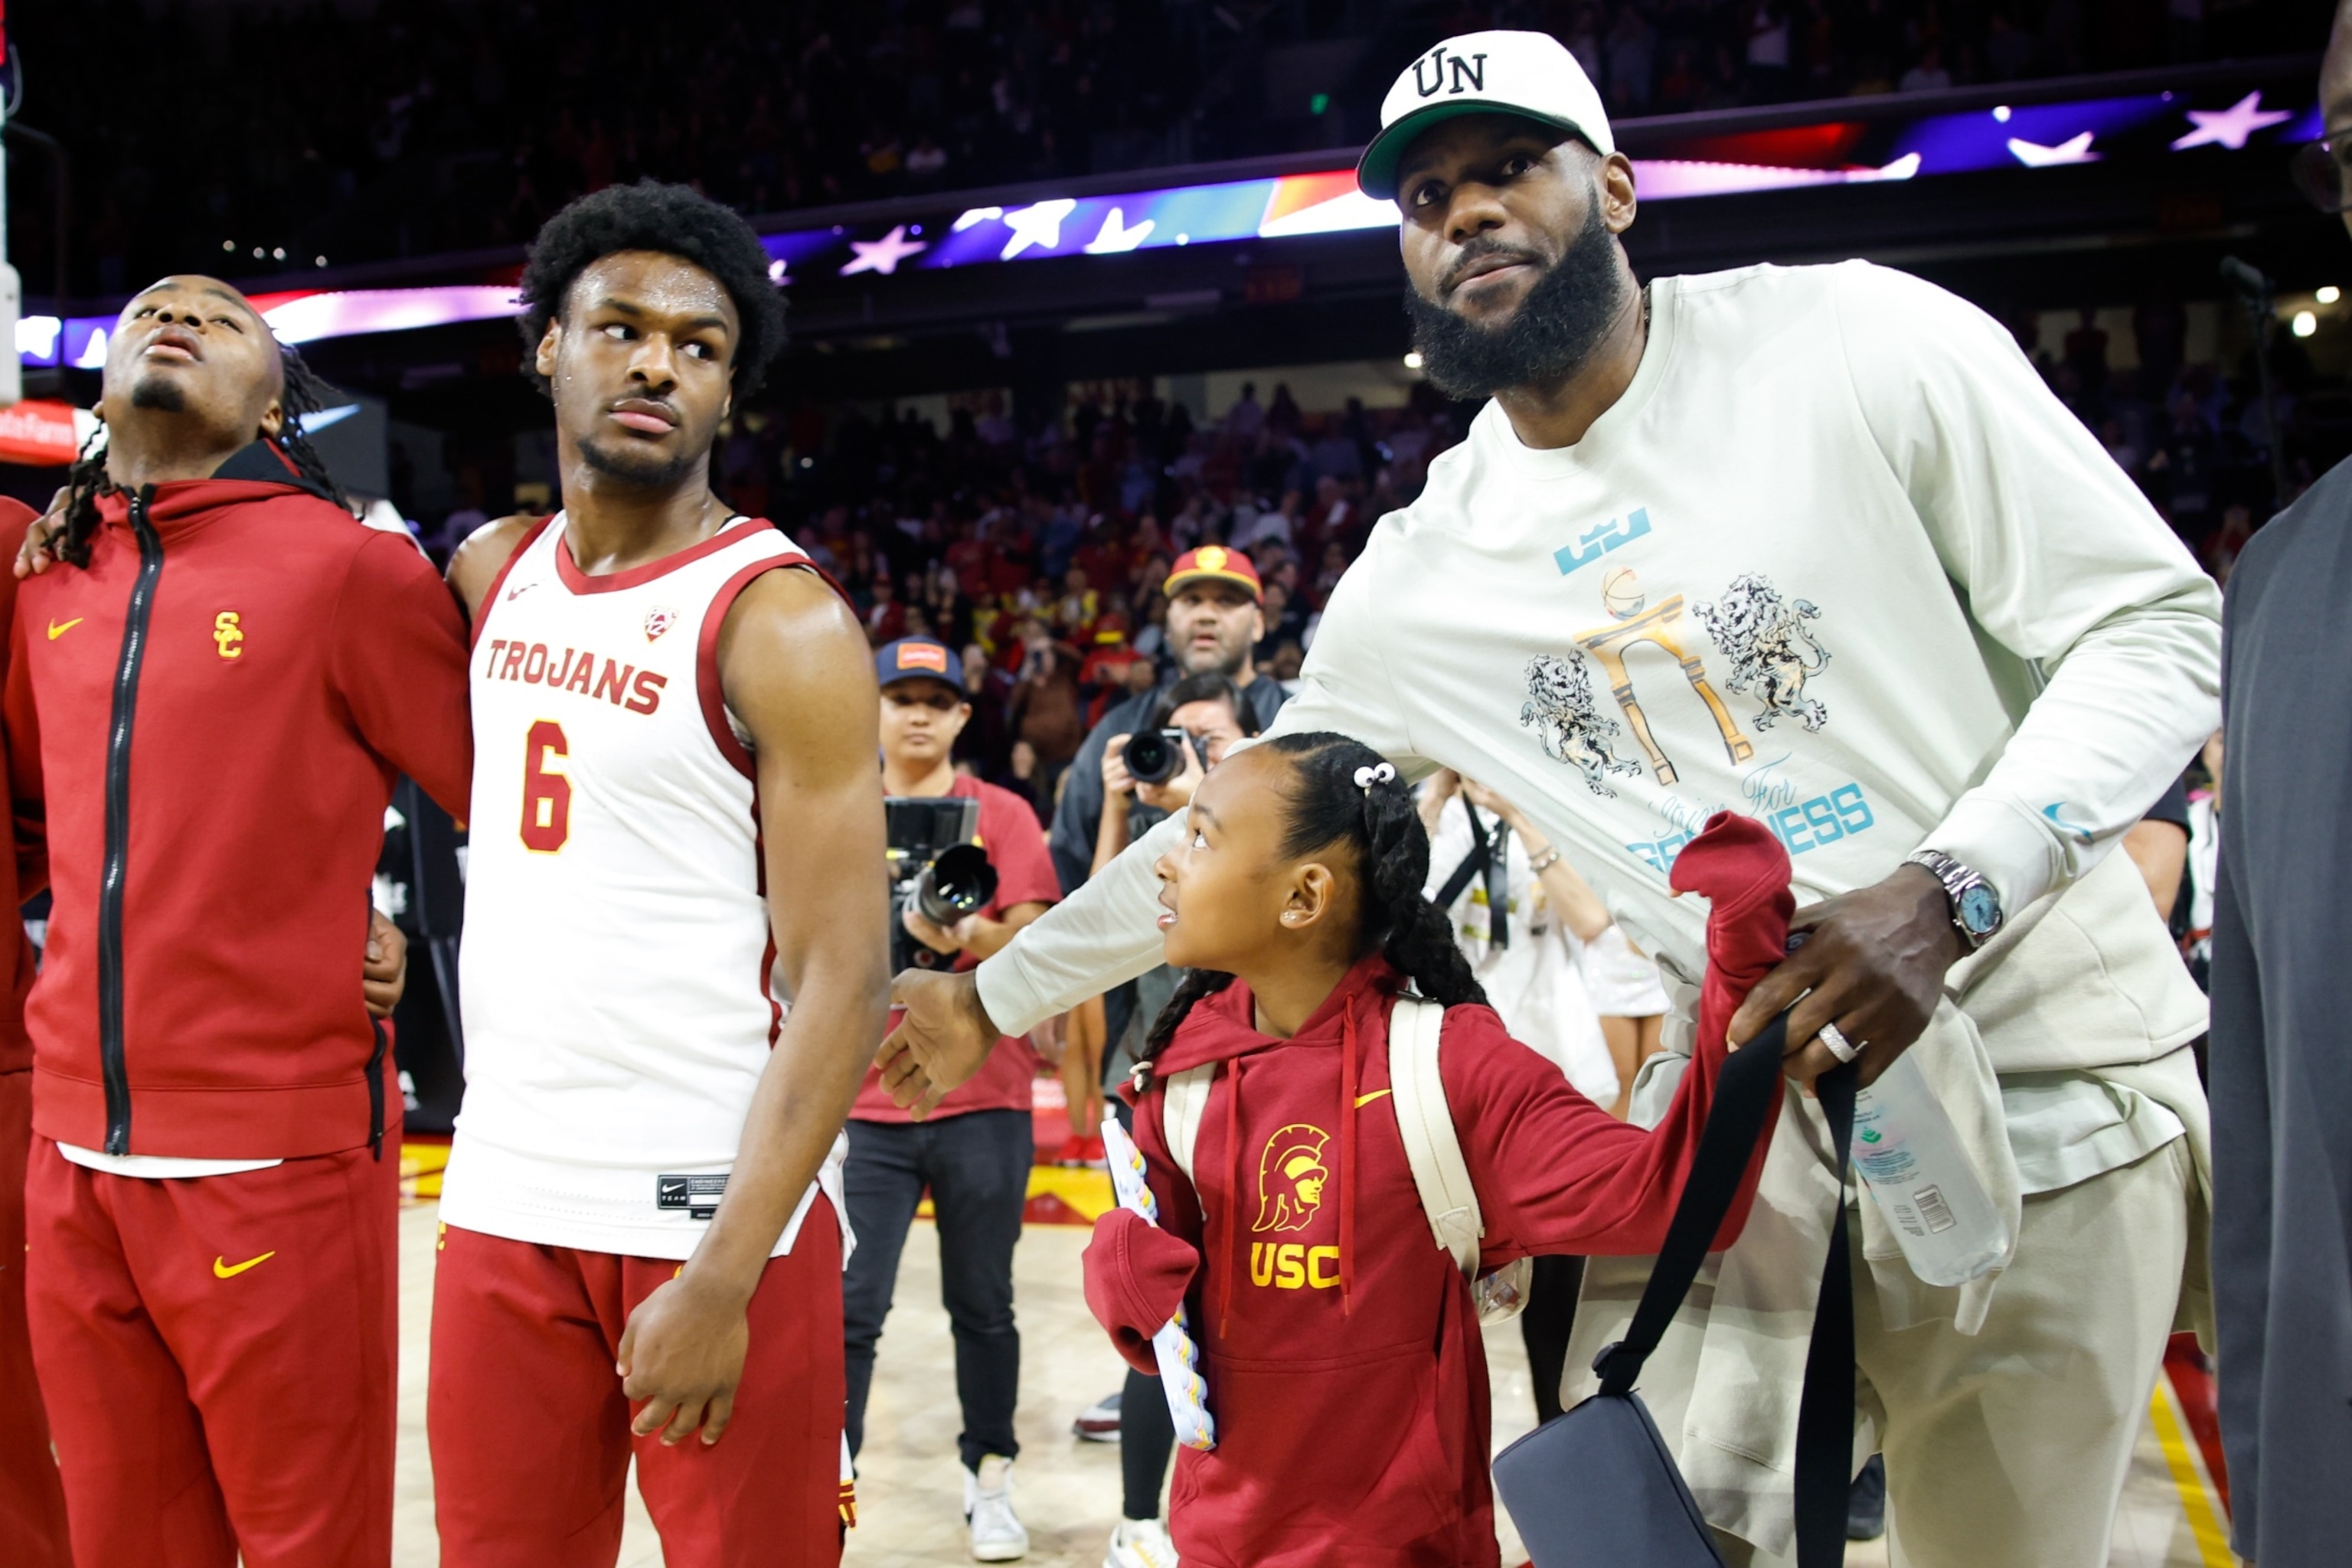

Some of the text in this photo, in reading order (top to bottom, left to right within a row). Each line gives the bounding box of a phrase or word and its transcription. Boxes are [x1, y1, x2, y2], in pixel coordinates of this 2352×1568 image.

[1412, 46, 1488, 98] UN
[487, 639, 668, 716] TROJANS
[519, 718, 573, 854] 6
[1250, 1242, 1341, 1290] USC
